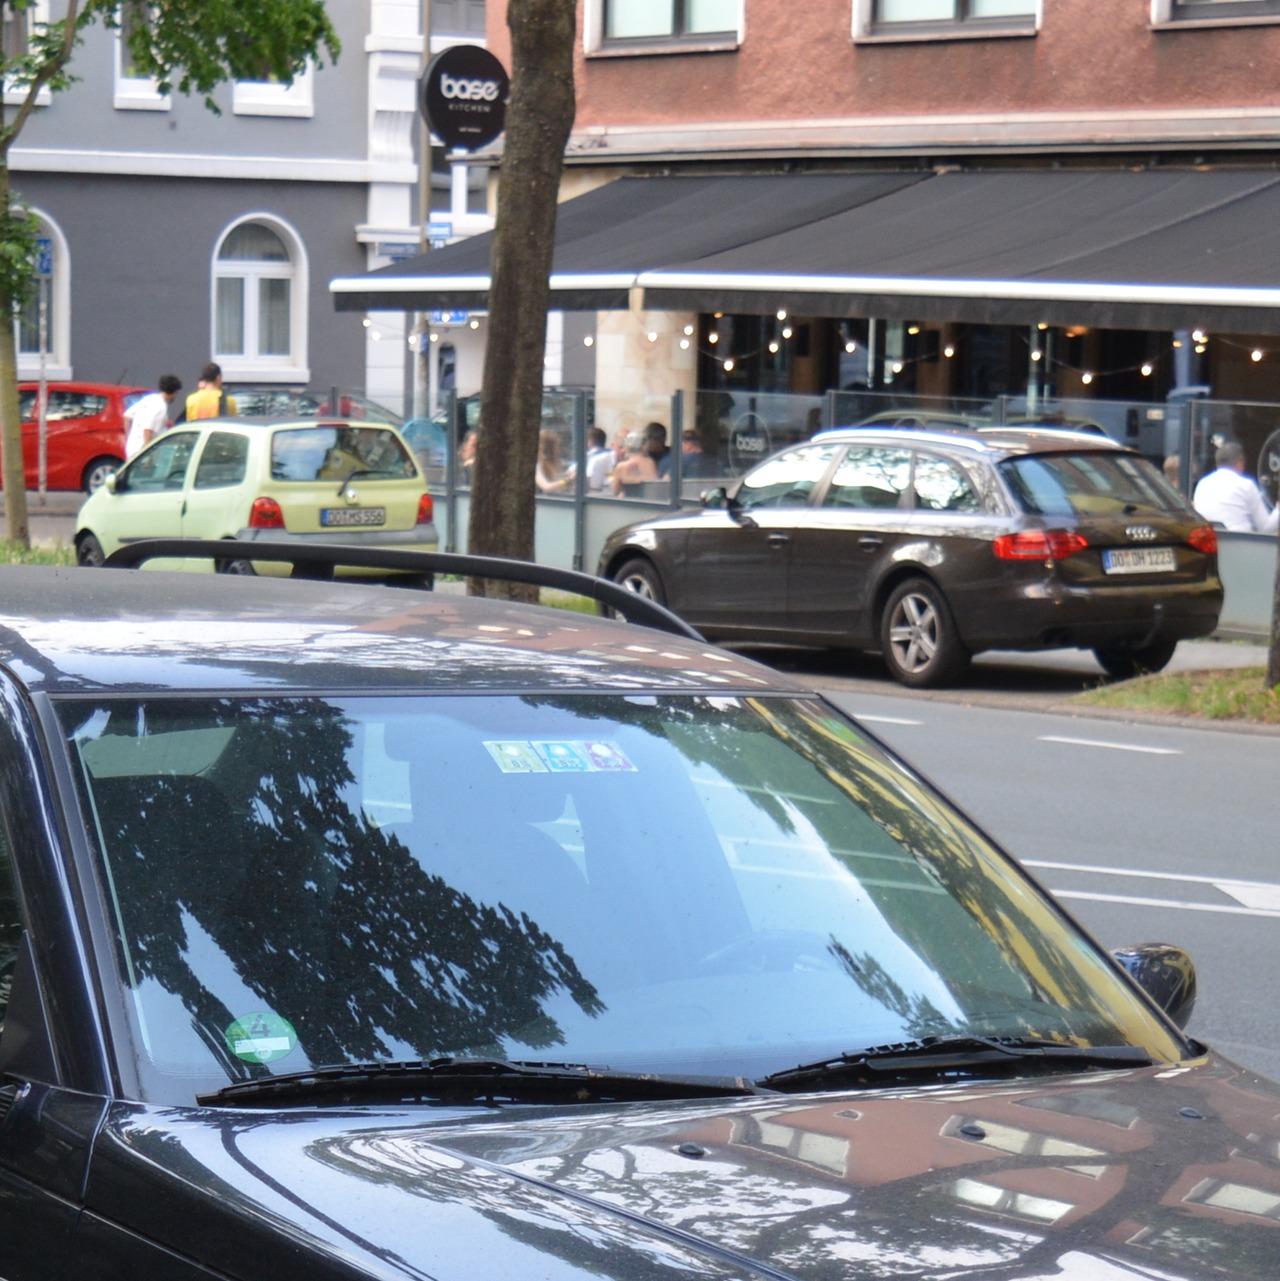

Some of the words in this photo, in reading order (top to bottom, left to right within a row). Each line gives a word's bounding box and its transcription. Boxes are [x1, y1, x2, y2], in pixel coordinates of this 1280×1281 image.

[441, 73, 500, 101] base
[736, 433, 766, 451] base
[1111, 553, 1124, 568] DO
[251, 1014, 271, 1036] 4
